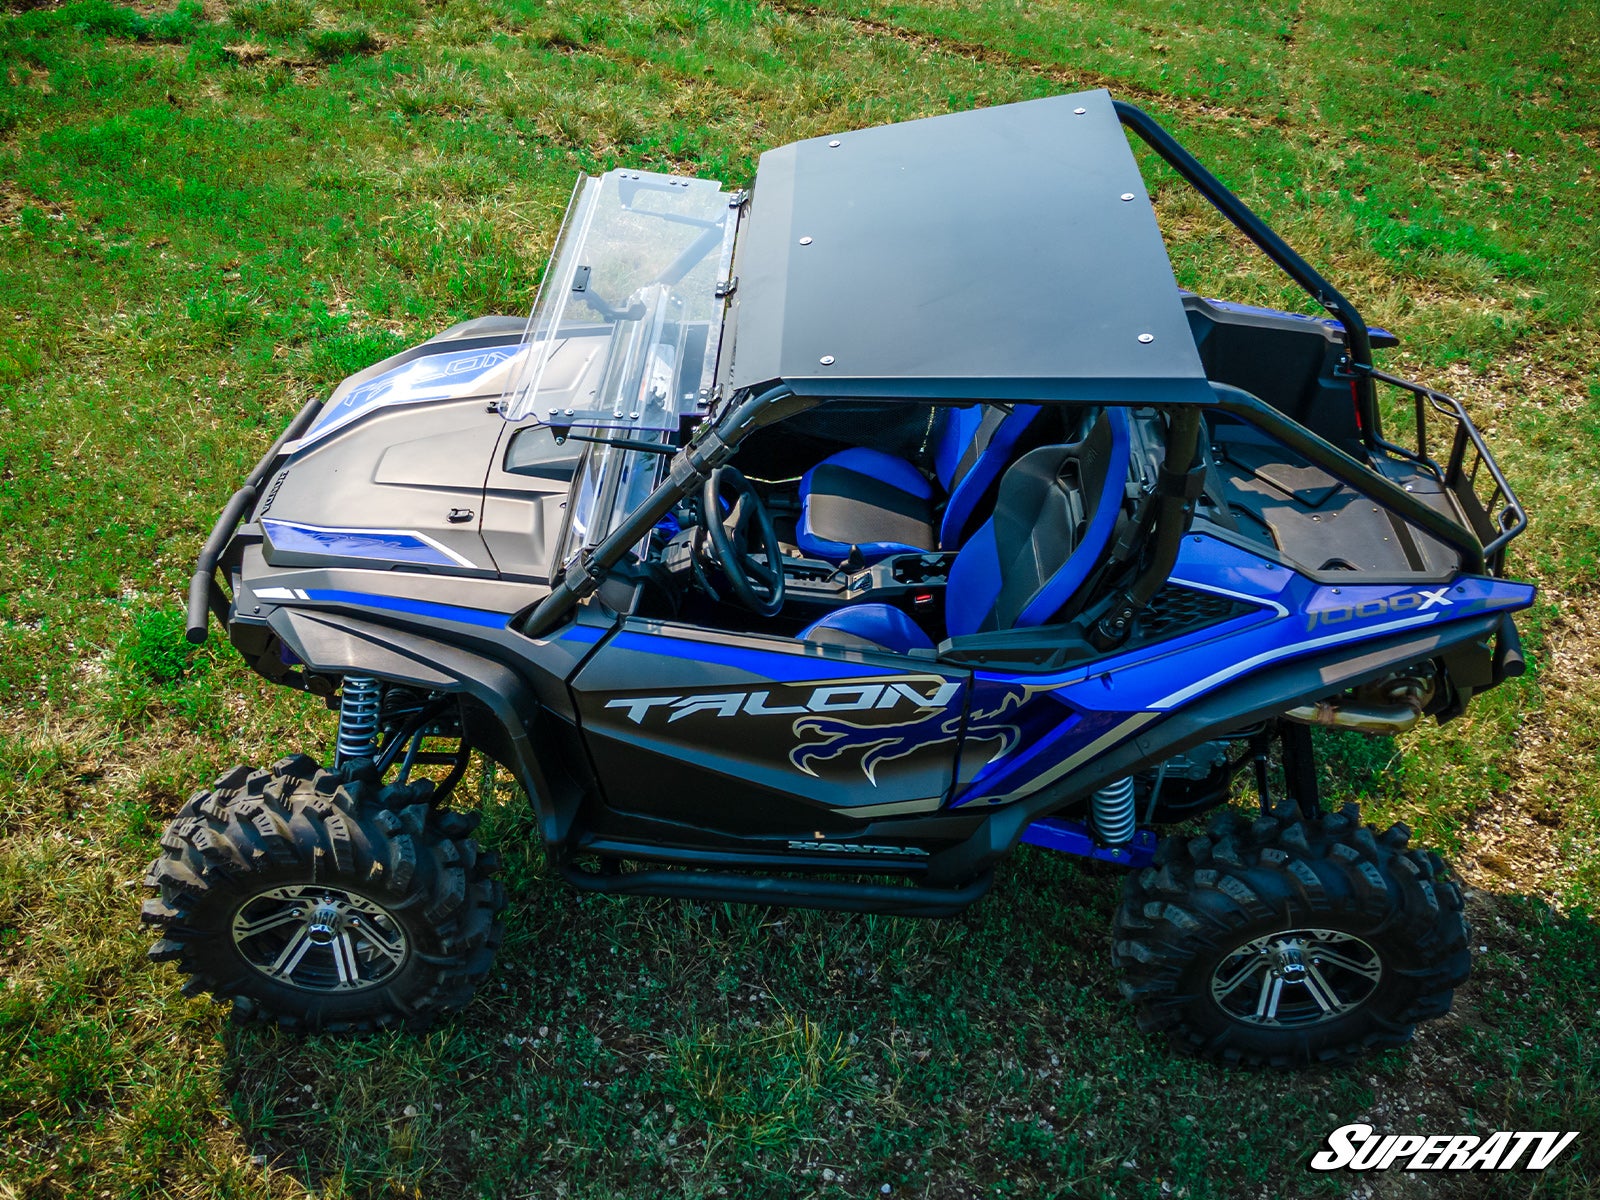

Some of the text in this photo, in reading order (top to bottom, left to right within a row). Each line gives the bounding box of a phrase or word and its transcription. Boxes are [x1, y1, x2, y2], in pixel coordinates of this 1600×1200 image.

[1306, 587, 1454, 632] 1000X
[605, 682, 962, 724] TALON
[787, 840, 931, 856] HONDA
